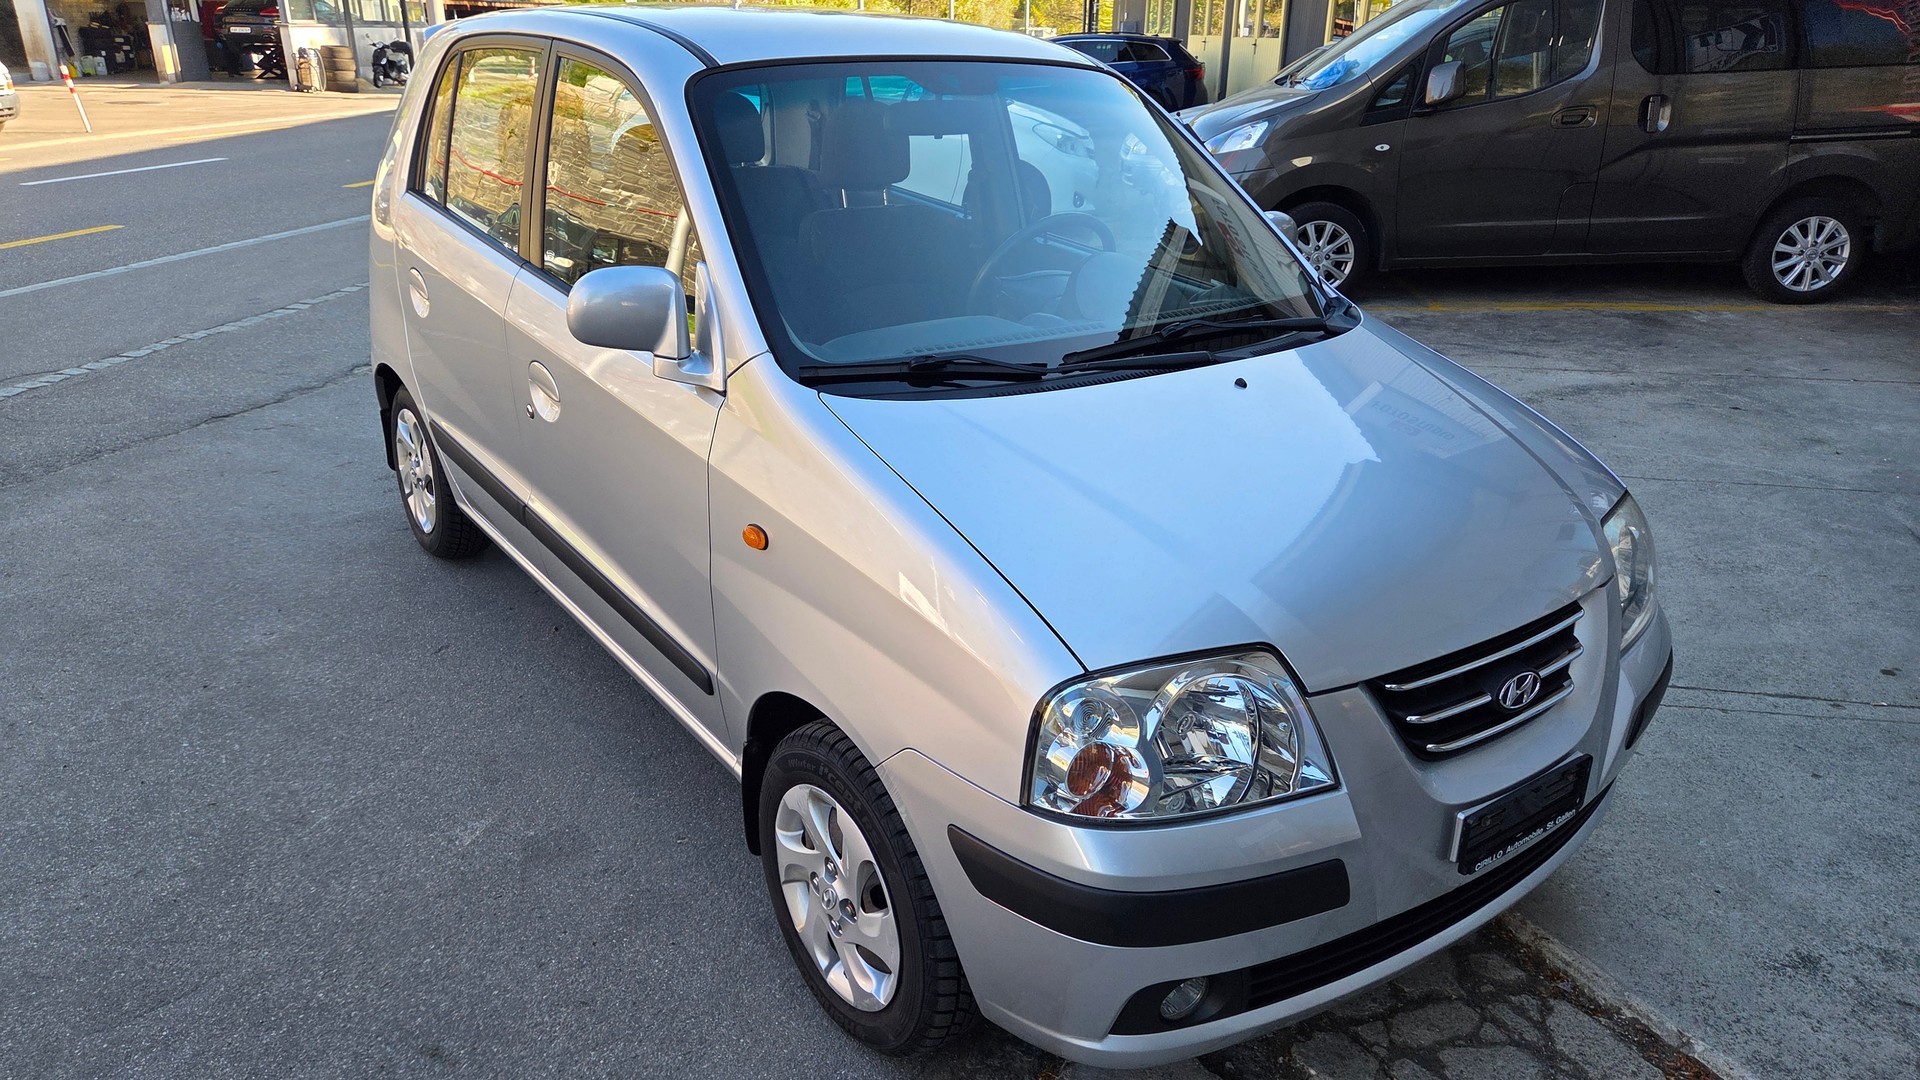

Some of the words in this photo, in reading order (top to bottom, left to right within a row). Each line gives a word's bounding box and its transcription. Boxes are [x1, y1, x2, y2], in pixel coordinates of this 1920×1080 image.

[788, 758, 816, 771] Winter
[1474, 850, 1503, 872] CIRILLO
[1505, 827, 1544, 853] Automobile
[1555, 809, 1576, 824] Gallen
